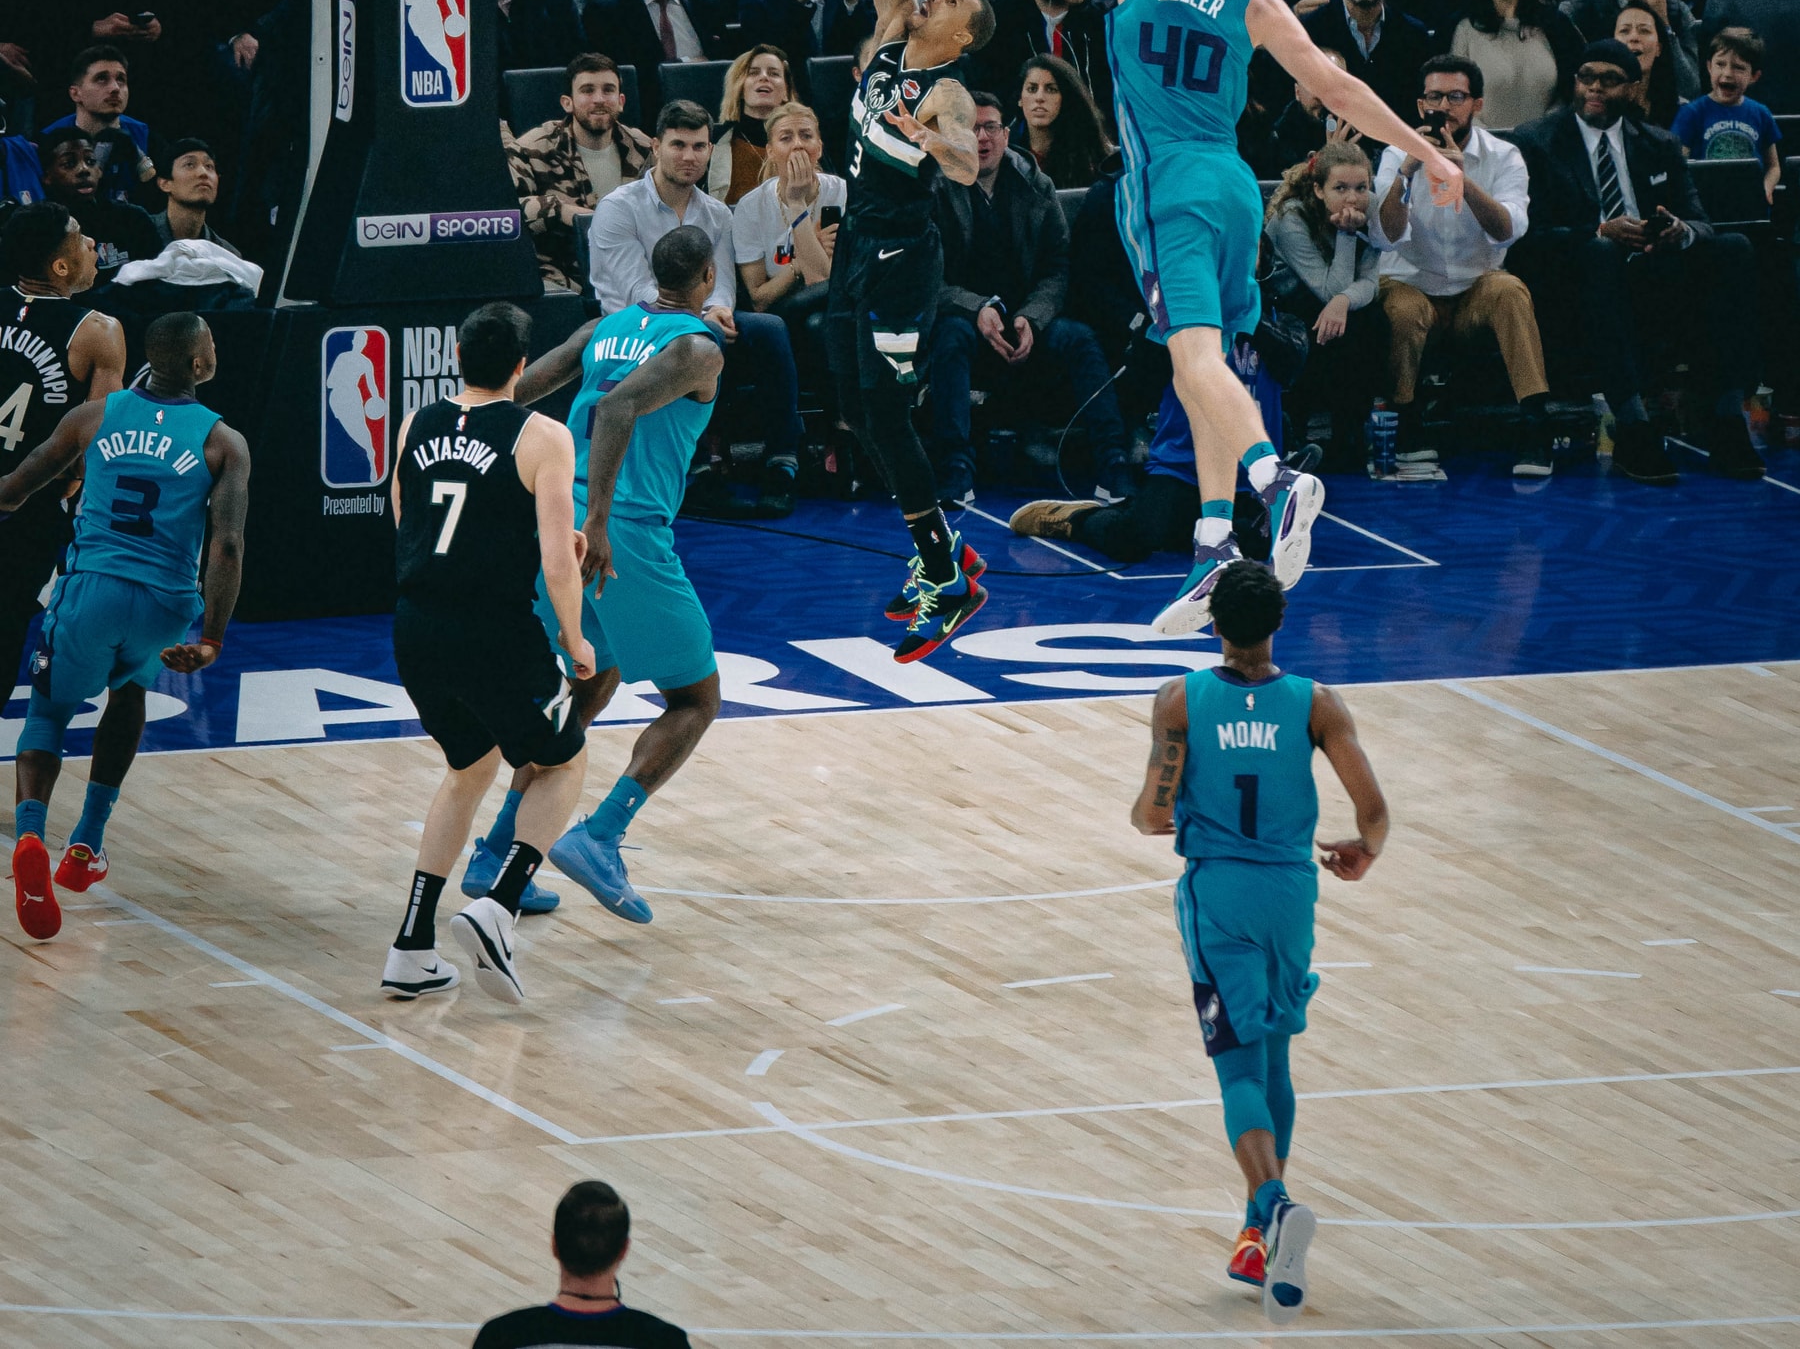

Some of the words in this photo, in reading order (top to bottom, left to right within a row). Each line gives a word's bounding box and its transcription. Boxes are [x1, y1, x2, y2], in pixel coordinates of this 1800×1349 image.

[338, 11, 352, 110] beIN
[411, 70, 444, 96] NBA
[1138, 21, 1228, 94] 40
[363, 219, 423, 241] beIN
[436, 216, 514, 238] SPORTS
[0, 325, 69, 405] KOUNMPO
[403, 326, 460, 378] NBA
[97, 430, 173, 462] ROZIER
[171, 449, 200, 476] III
[413, 435, 498, 476] ILYASOVA
[110, 475, 162, 538] 3
[323, 494, 372, 516] Presented
[373, 492, 385, 516] by
[430, 478, 468, 555] 7
[1216, 720, 1280, 751] MONK
[1233, 774, 1259, 840] 1
